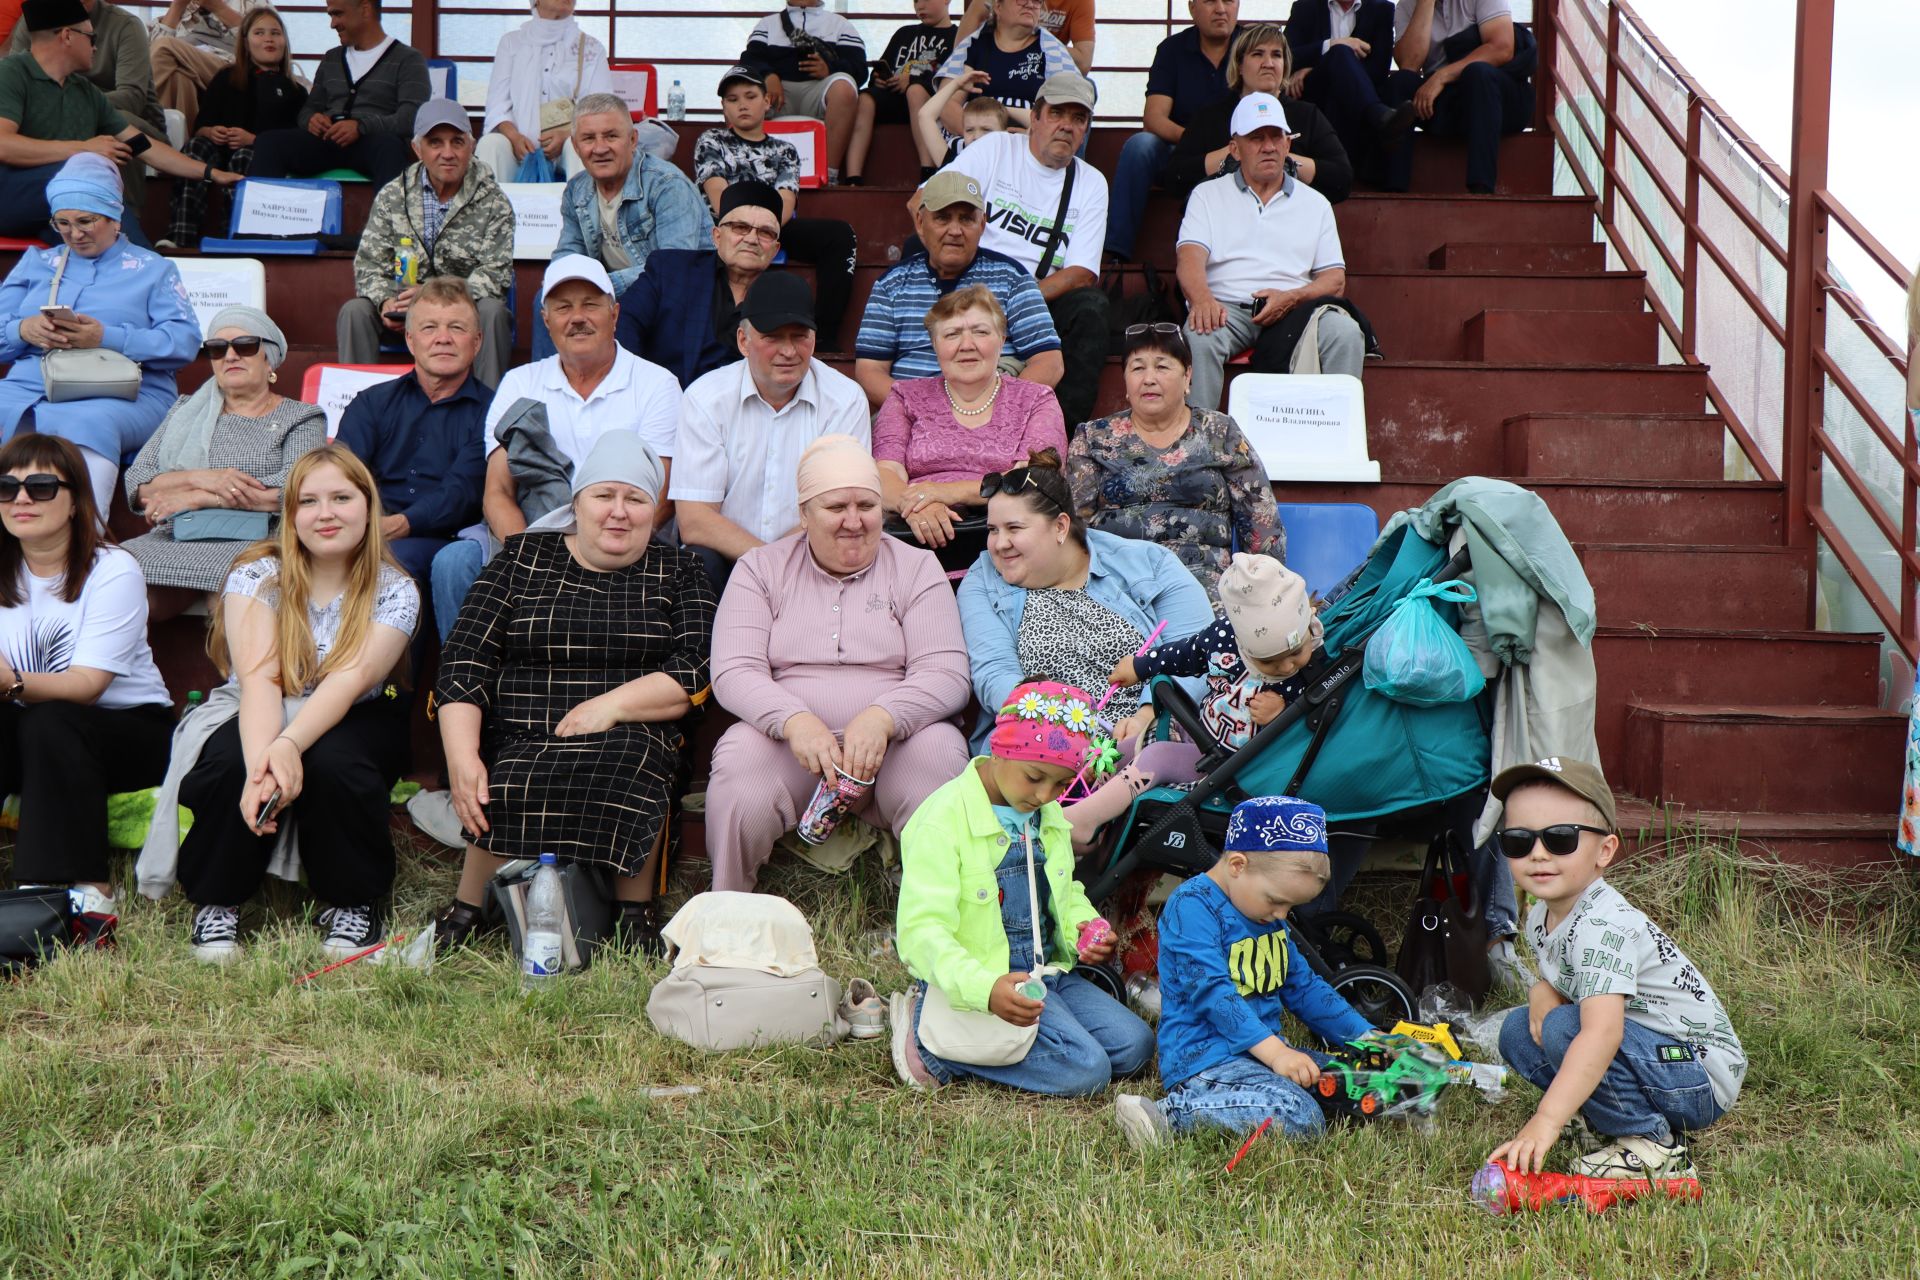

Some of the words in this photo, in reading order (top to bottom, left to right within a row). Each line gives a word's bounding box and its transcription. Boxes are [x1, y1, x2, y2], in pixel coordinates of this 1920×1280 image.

[1008, 63, 1040, 79] grateful
[1256, 415, 1280, 423] Ольга
[1282, 416, 1341, 427] Владимировна
[1272, 406, 1325, 416] ПАШАГИНА
[1321, 664, 1350, 690] Babalo
[1601, 930, 1625, 952] IN
[1582, 948, 1635, 981] TIME
[1680, 967, 1701, 987] GIVE
[1672, 976, 1706, 1002] DON'T
